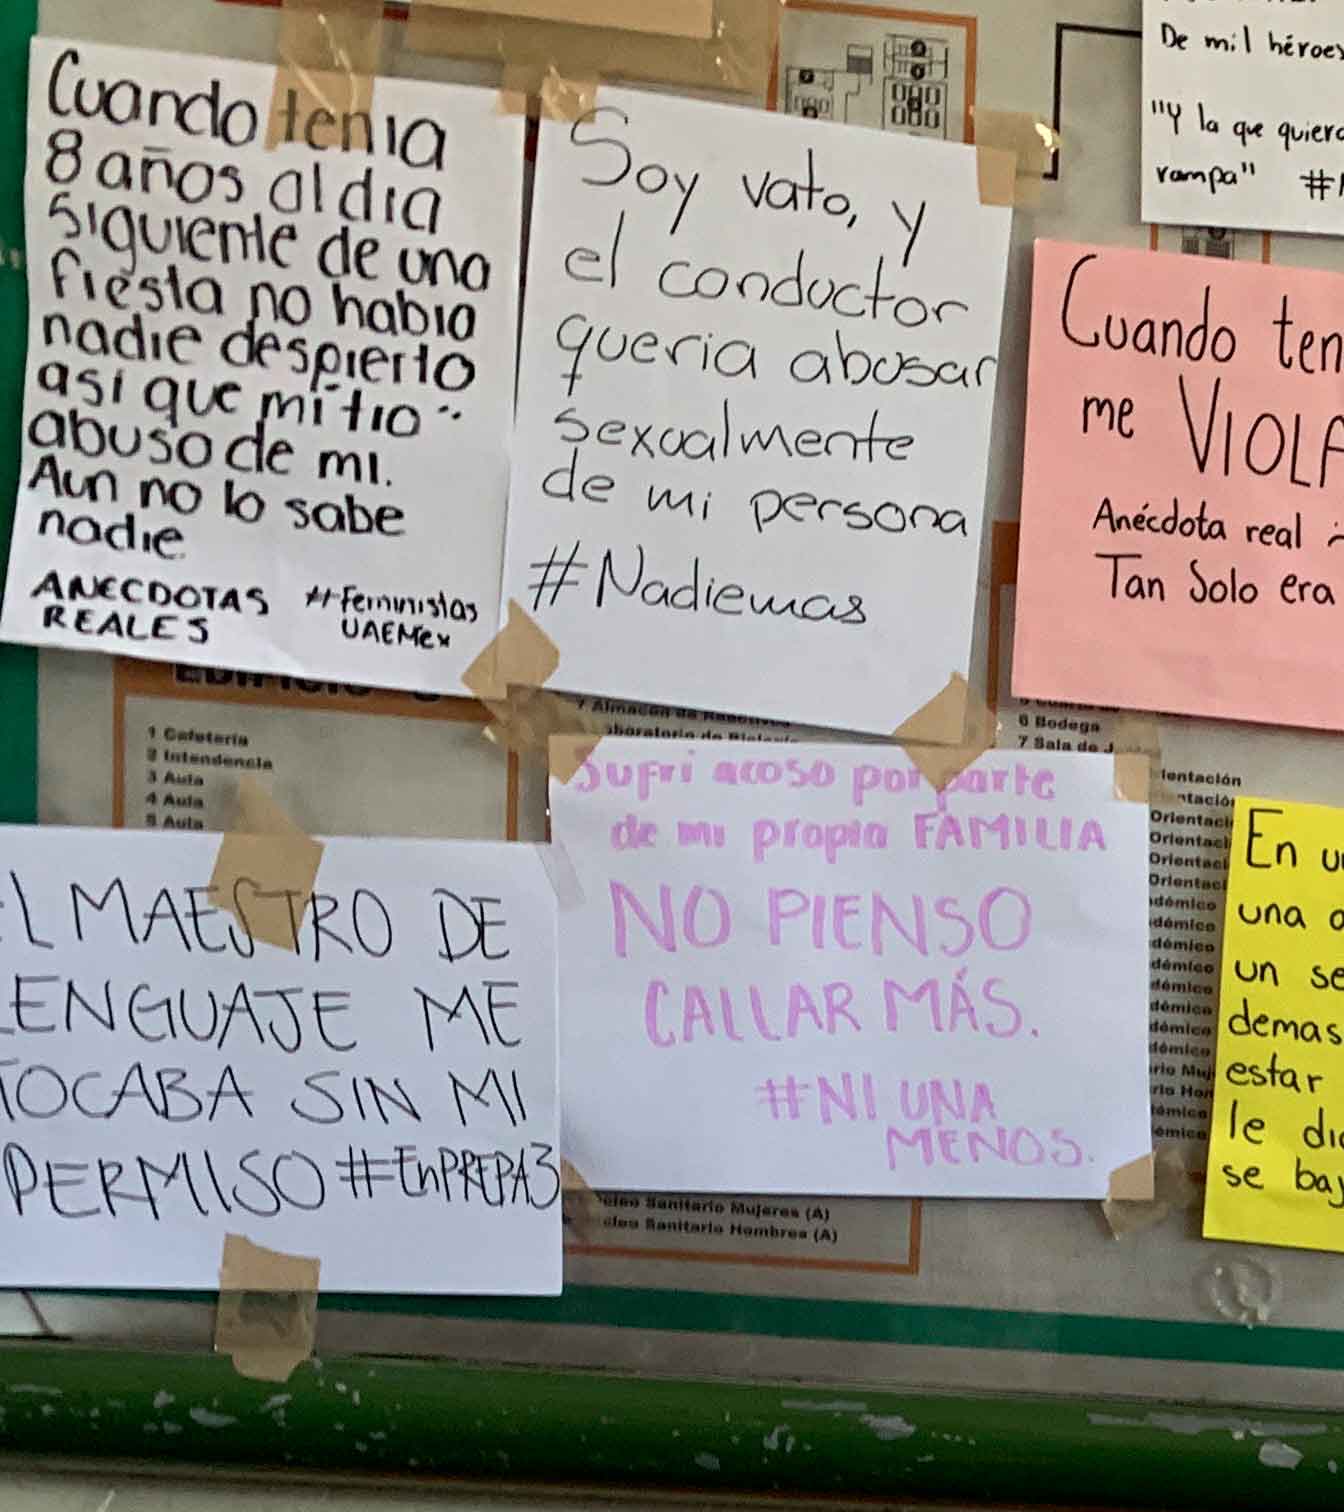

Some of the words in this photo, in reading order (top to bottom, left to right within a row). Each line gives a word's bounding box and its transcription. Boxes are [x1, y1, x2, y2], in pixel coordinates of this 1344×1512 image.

[1162, 23, 1189, 51] De
[1205, 26, 1251, 54] mil
[564, 212, 628, 287] el
[656, 249, 971, 326] conductor
[1062, 253, 1238, 365] Cuando
[556, 312, 758, 395] queria
[789, 330, 999, 387] abusar
[554, 400, 916, 466] sexualmente
[1080, 392, 1135, 441] me
[1093, 496, 1226, 541] Anécdota
[1246, 517, 1304, 550] real
[527, 537, 868, 628] #Nadiemas
[1093, 551, 1166, 603] Tan
[1189, 555, 1258, 607] Solo
[1279, 569, 1336, 609] era
[1248, 810, 1297, 870] En
[609, 880, 732, 958] NO
[768, 885, 1034, 954] PIENSO
[645, 980, 863, 1047] CALLAR
[886, 968, 1040, 1040] MÁS.
